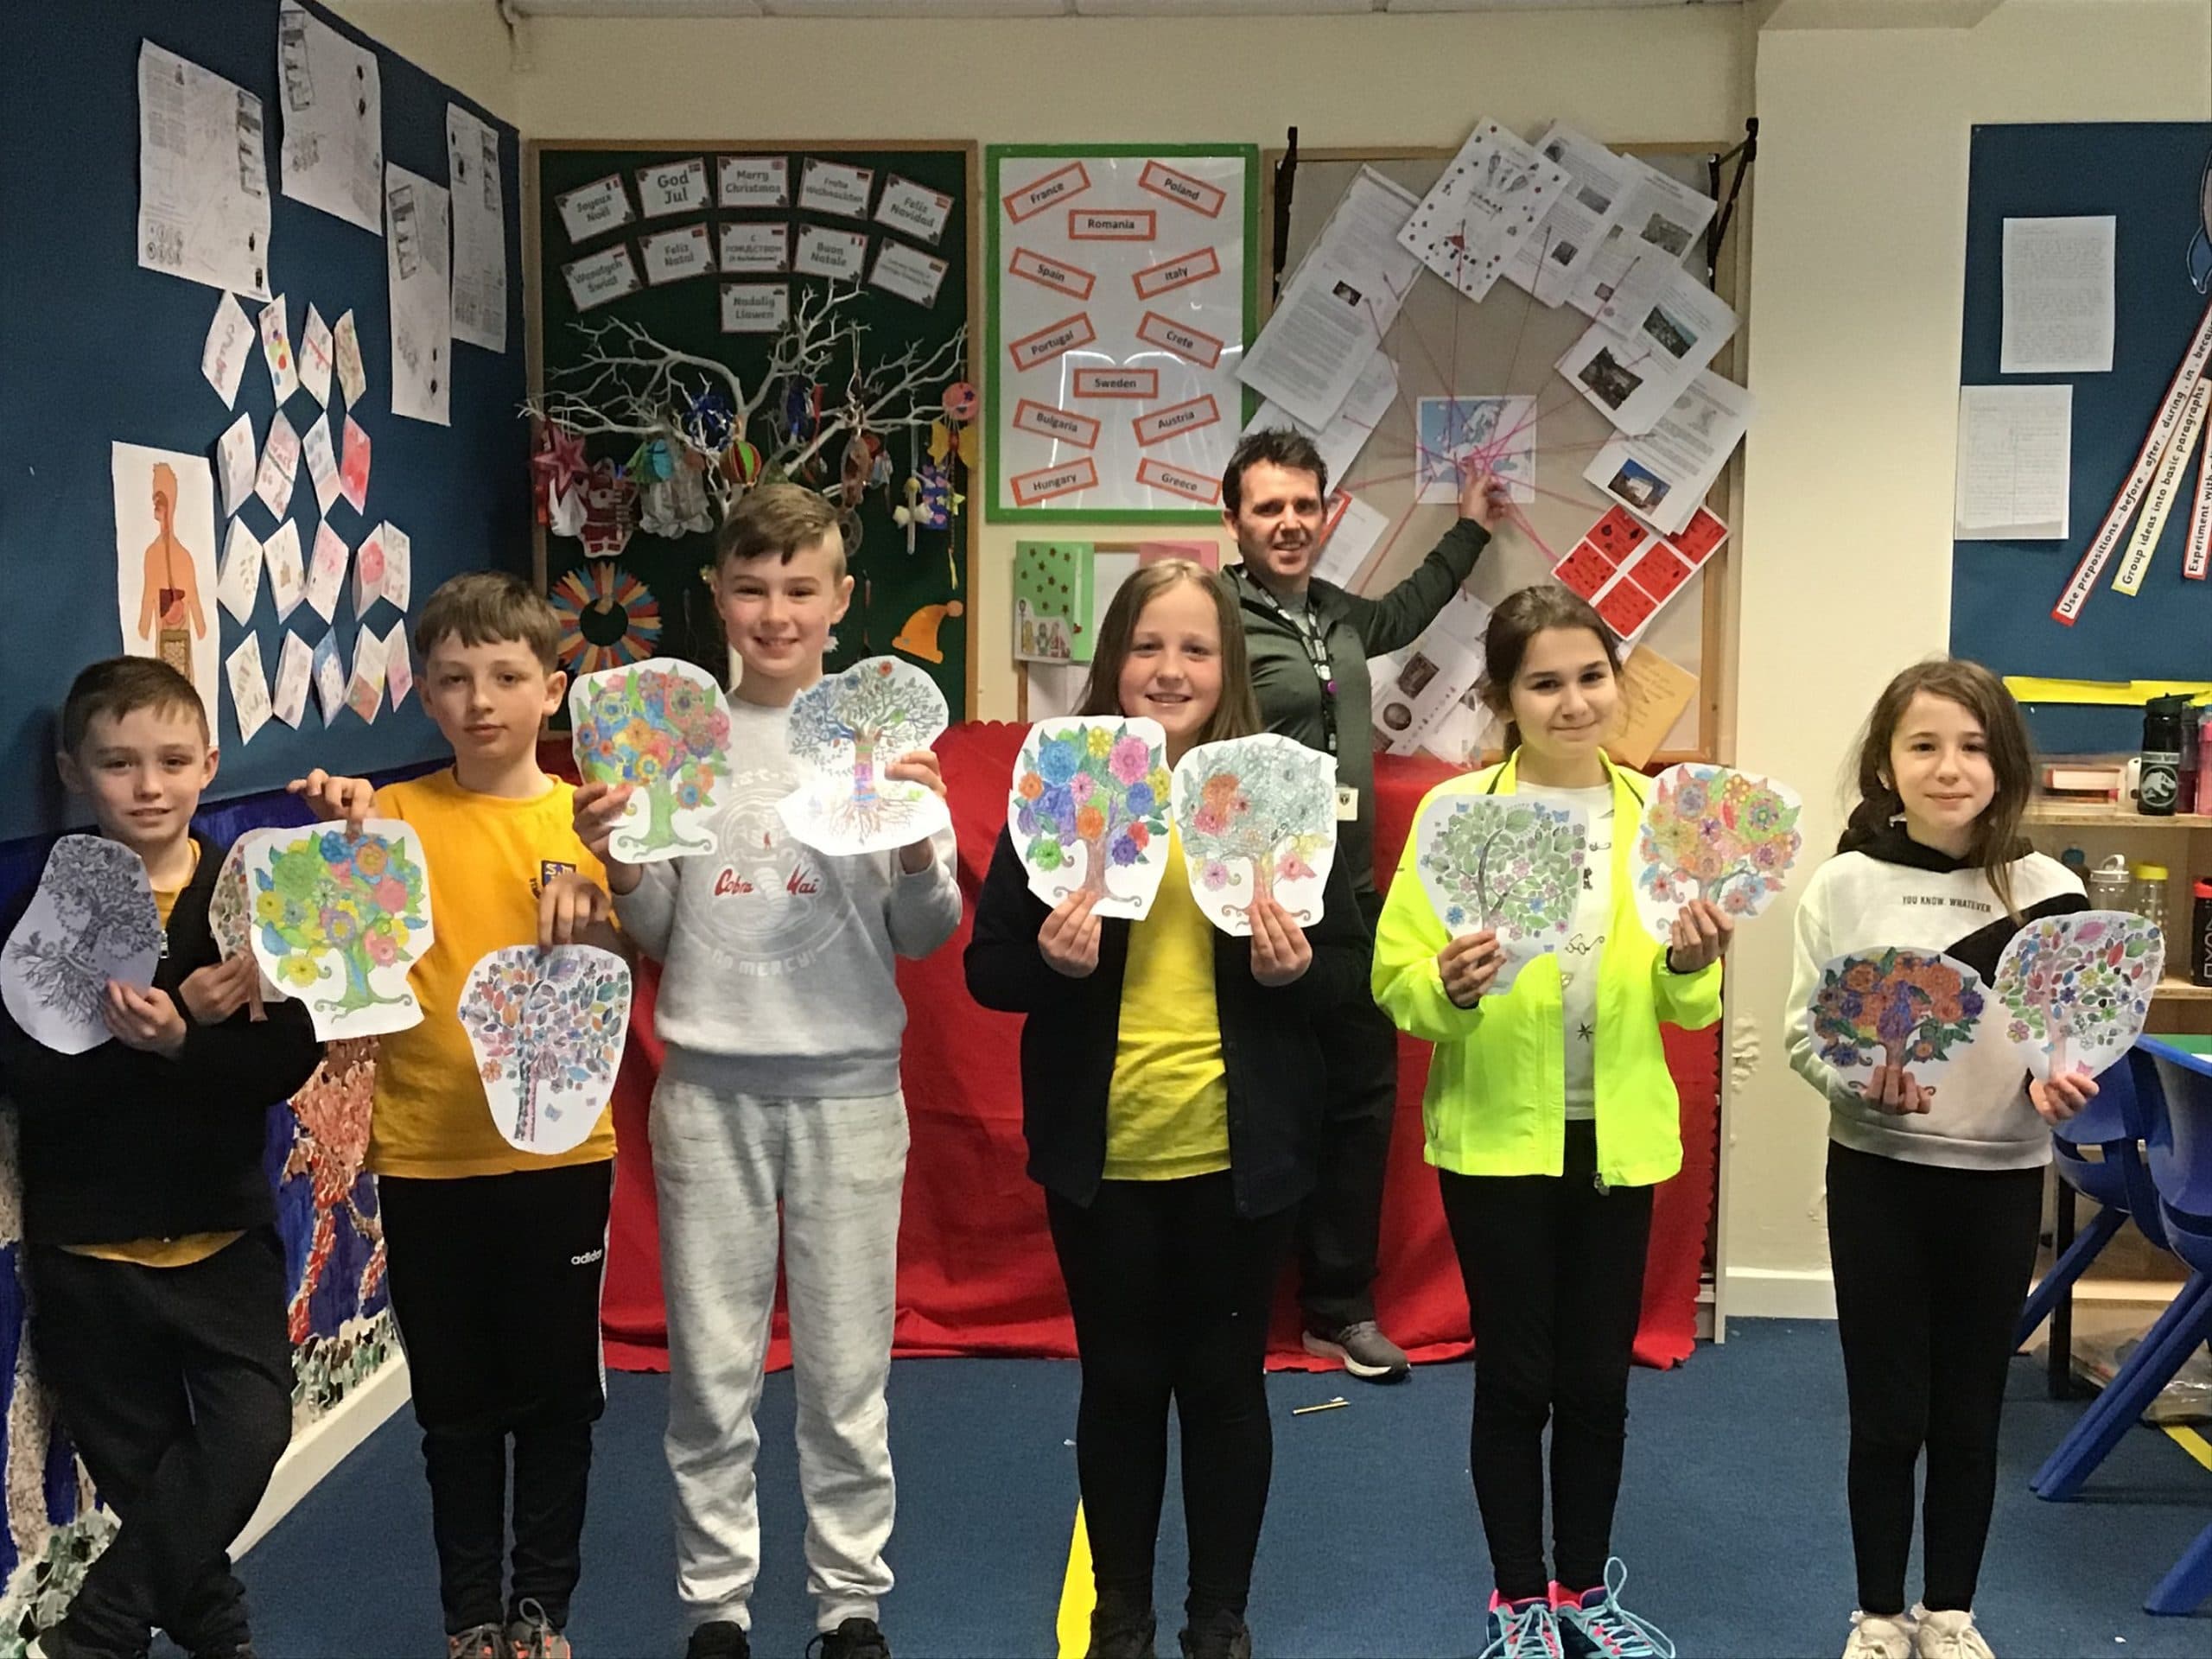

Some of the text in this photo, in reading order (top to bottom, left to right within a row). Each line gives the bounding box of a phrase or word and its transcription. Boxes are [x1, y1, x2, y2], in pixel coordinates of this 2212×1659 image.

[658, 170, 690, 188] God
[737, 170, 769, 181] Merry
[664, 188, 688, 204] Jul
[725, 182, 781, 194] Christmas
[1030, 181, 1065, 204] France
[1164, 178, 1200, 201] Poland
[904, 197, 928, 213] Feliz
[891, 203, 935, 227] Navidad
[1088, 219, 1135, 230] Romania
[664, 243, 689, 255] Feliz
[817, 242, 844, 256] Buon
[810, 252, 847, 267] Natale
[1038, 264, 1065, 283] Spain
[1165, 266, 1188, 281] Italy
[1031, 330, 1074, 355] Portugal
[1166, 330, 1193, 350] Crete
[1094, 378, 1137, 389] Sweden
[1036, 412, 1078, 433] Bulgaria
[1158, 410, 1194, 429] Austria
[1033, 474, 1077, 492] Hungary
[1161, 473, 1198, 492] Greece
[2061, 591, 2079, 613] Use
[2077, 522, 2119, 591] prepositions
[2145, 441, 2161, 467] after
[2162, 391, 2187, 429] during
[2184, 369, 2196, 381] in
[2122, 550, 2146, 585] Group
[2139, 515, 2158, 546] ideas
[2153, 489, 2167, 512] into
[2161, 456, 2180, 486] basic
[2189, 505, 2209, 572] Experiment
[715, 868, 753, 896] Cobra
[786, 864, 819, 894] Kai
[1903, 896, 1917, 906] YOU
[1949, 898, 1991, 912] WHATEVER
